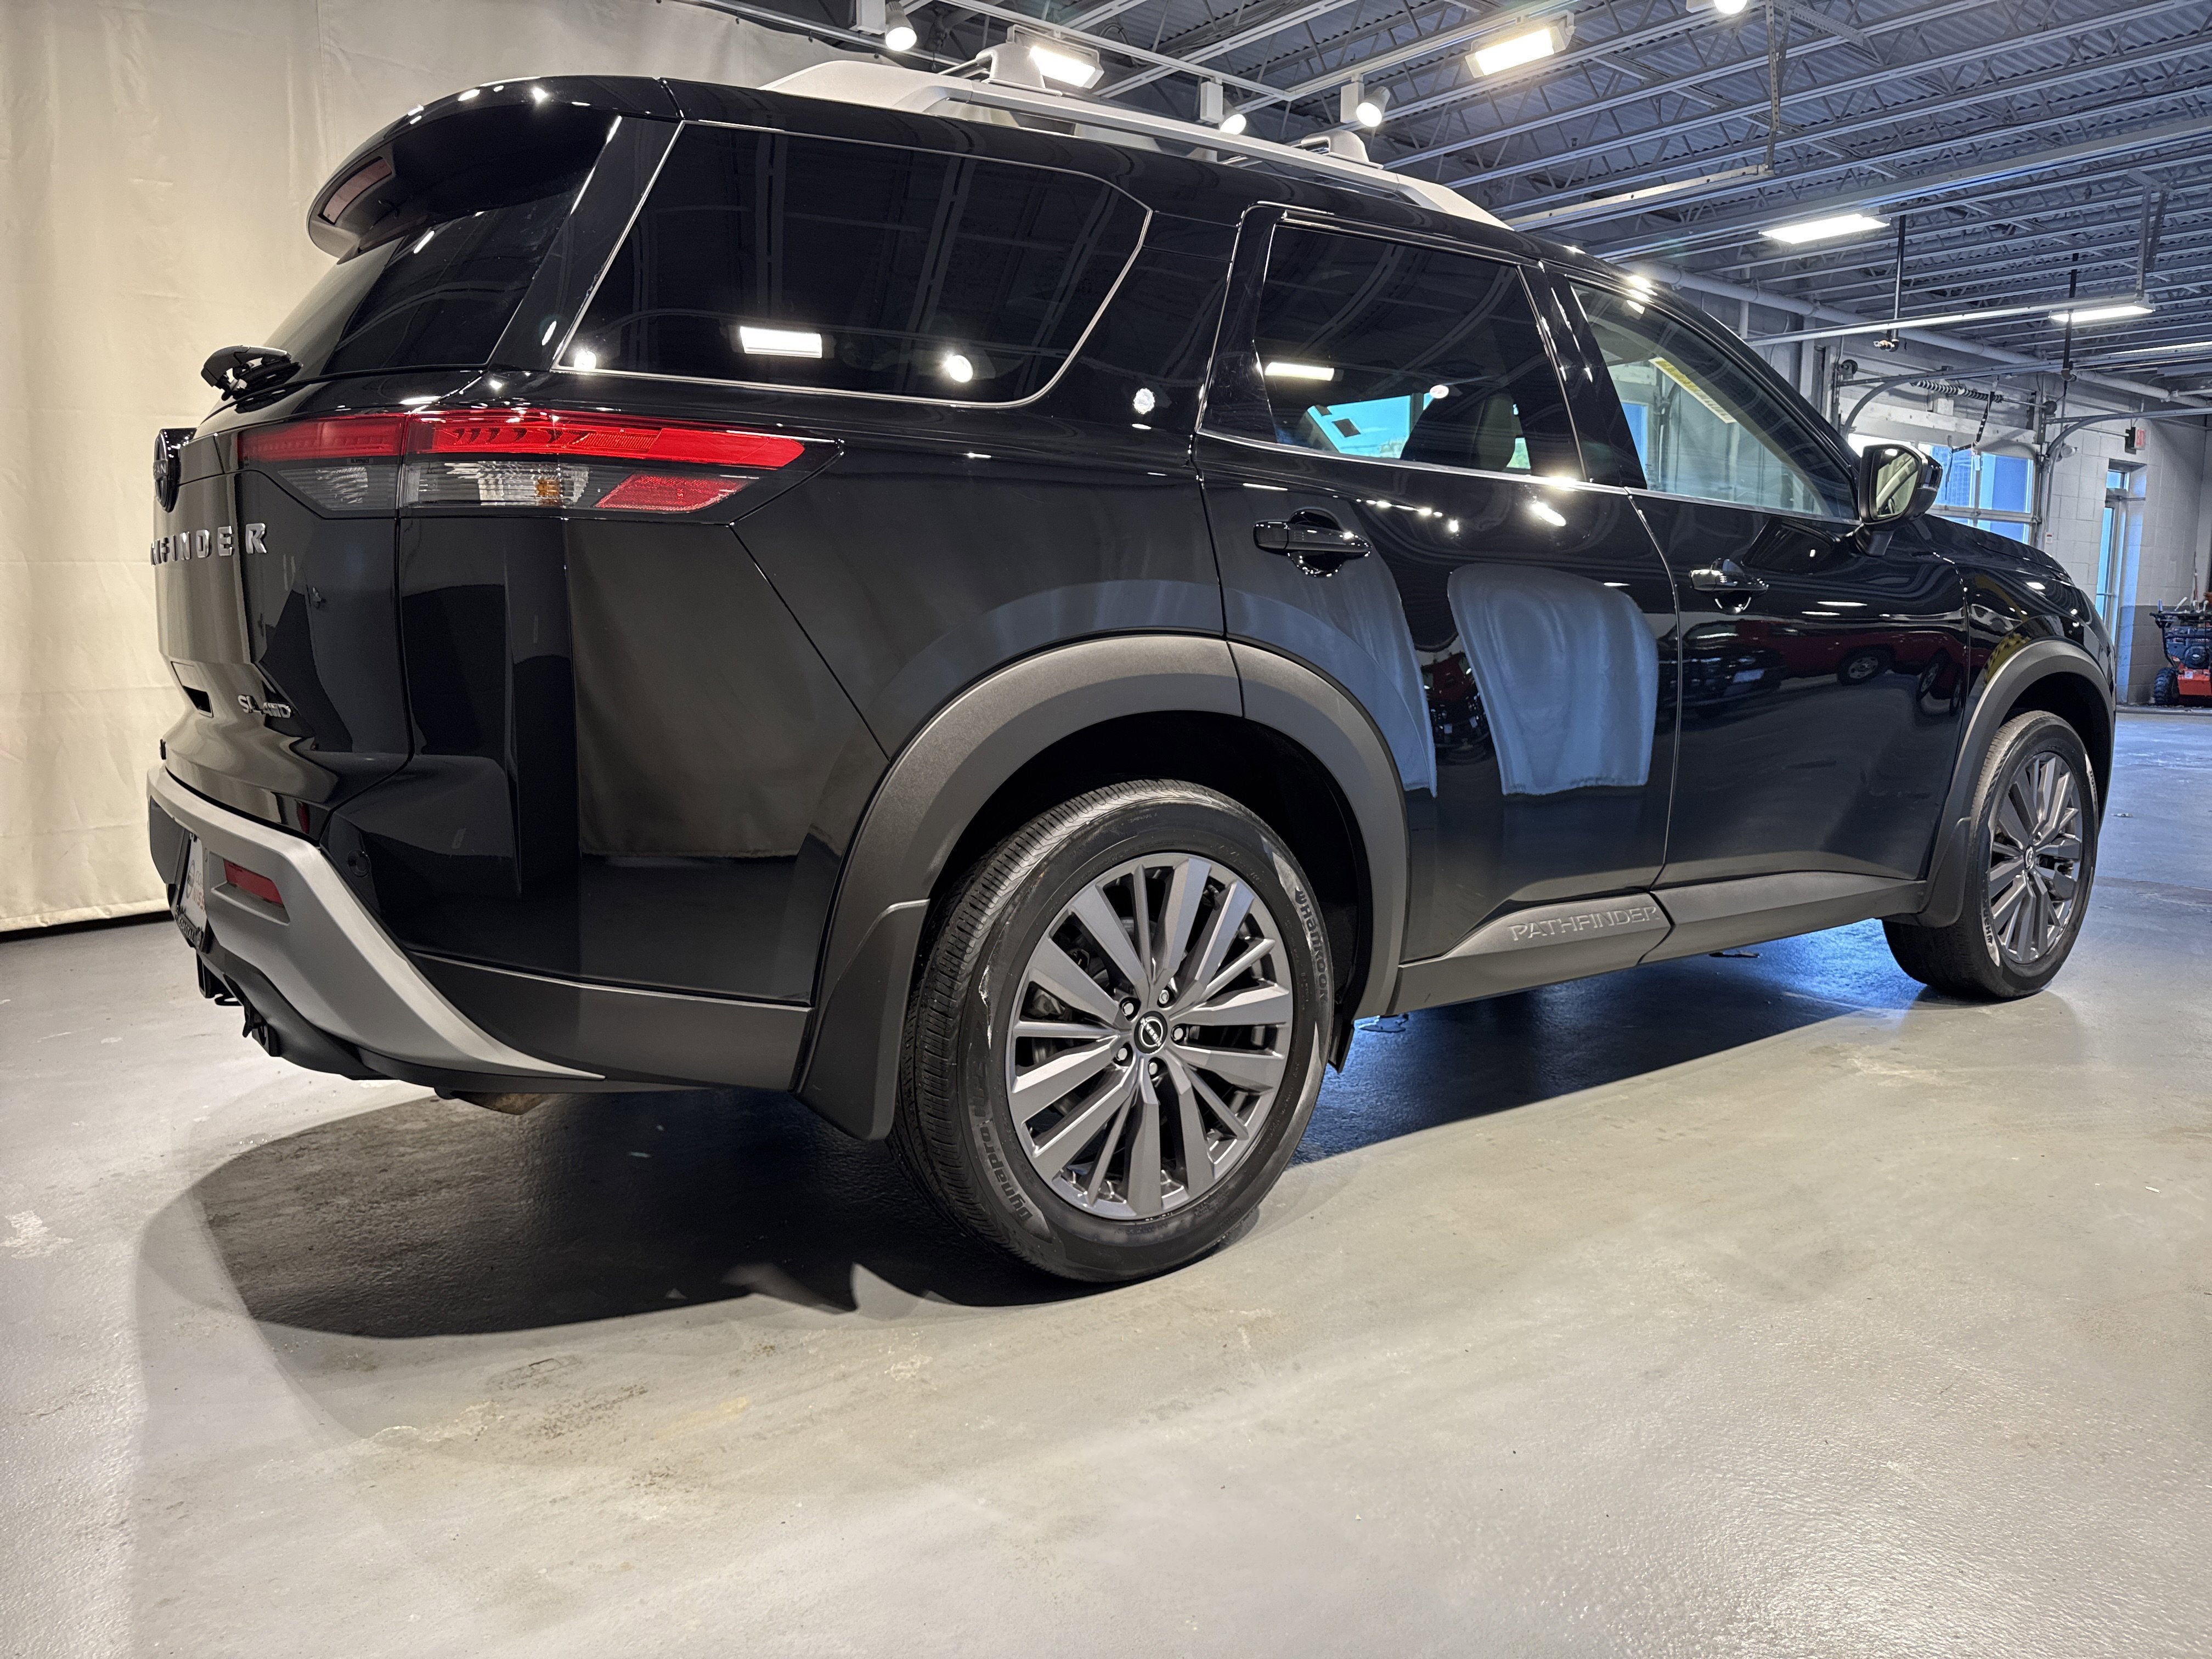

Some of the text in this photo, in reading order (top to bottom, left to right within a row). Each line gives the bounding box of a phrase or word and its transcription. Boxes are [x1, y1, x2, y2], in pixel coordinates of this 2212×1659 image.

[238, 695, 263, 715] SL
[1508, 906, 1661, 941] PATHFINDER
[1141, 1017, 1162, 1047] NISSAN
